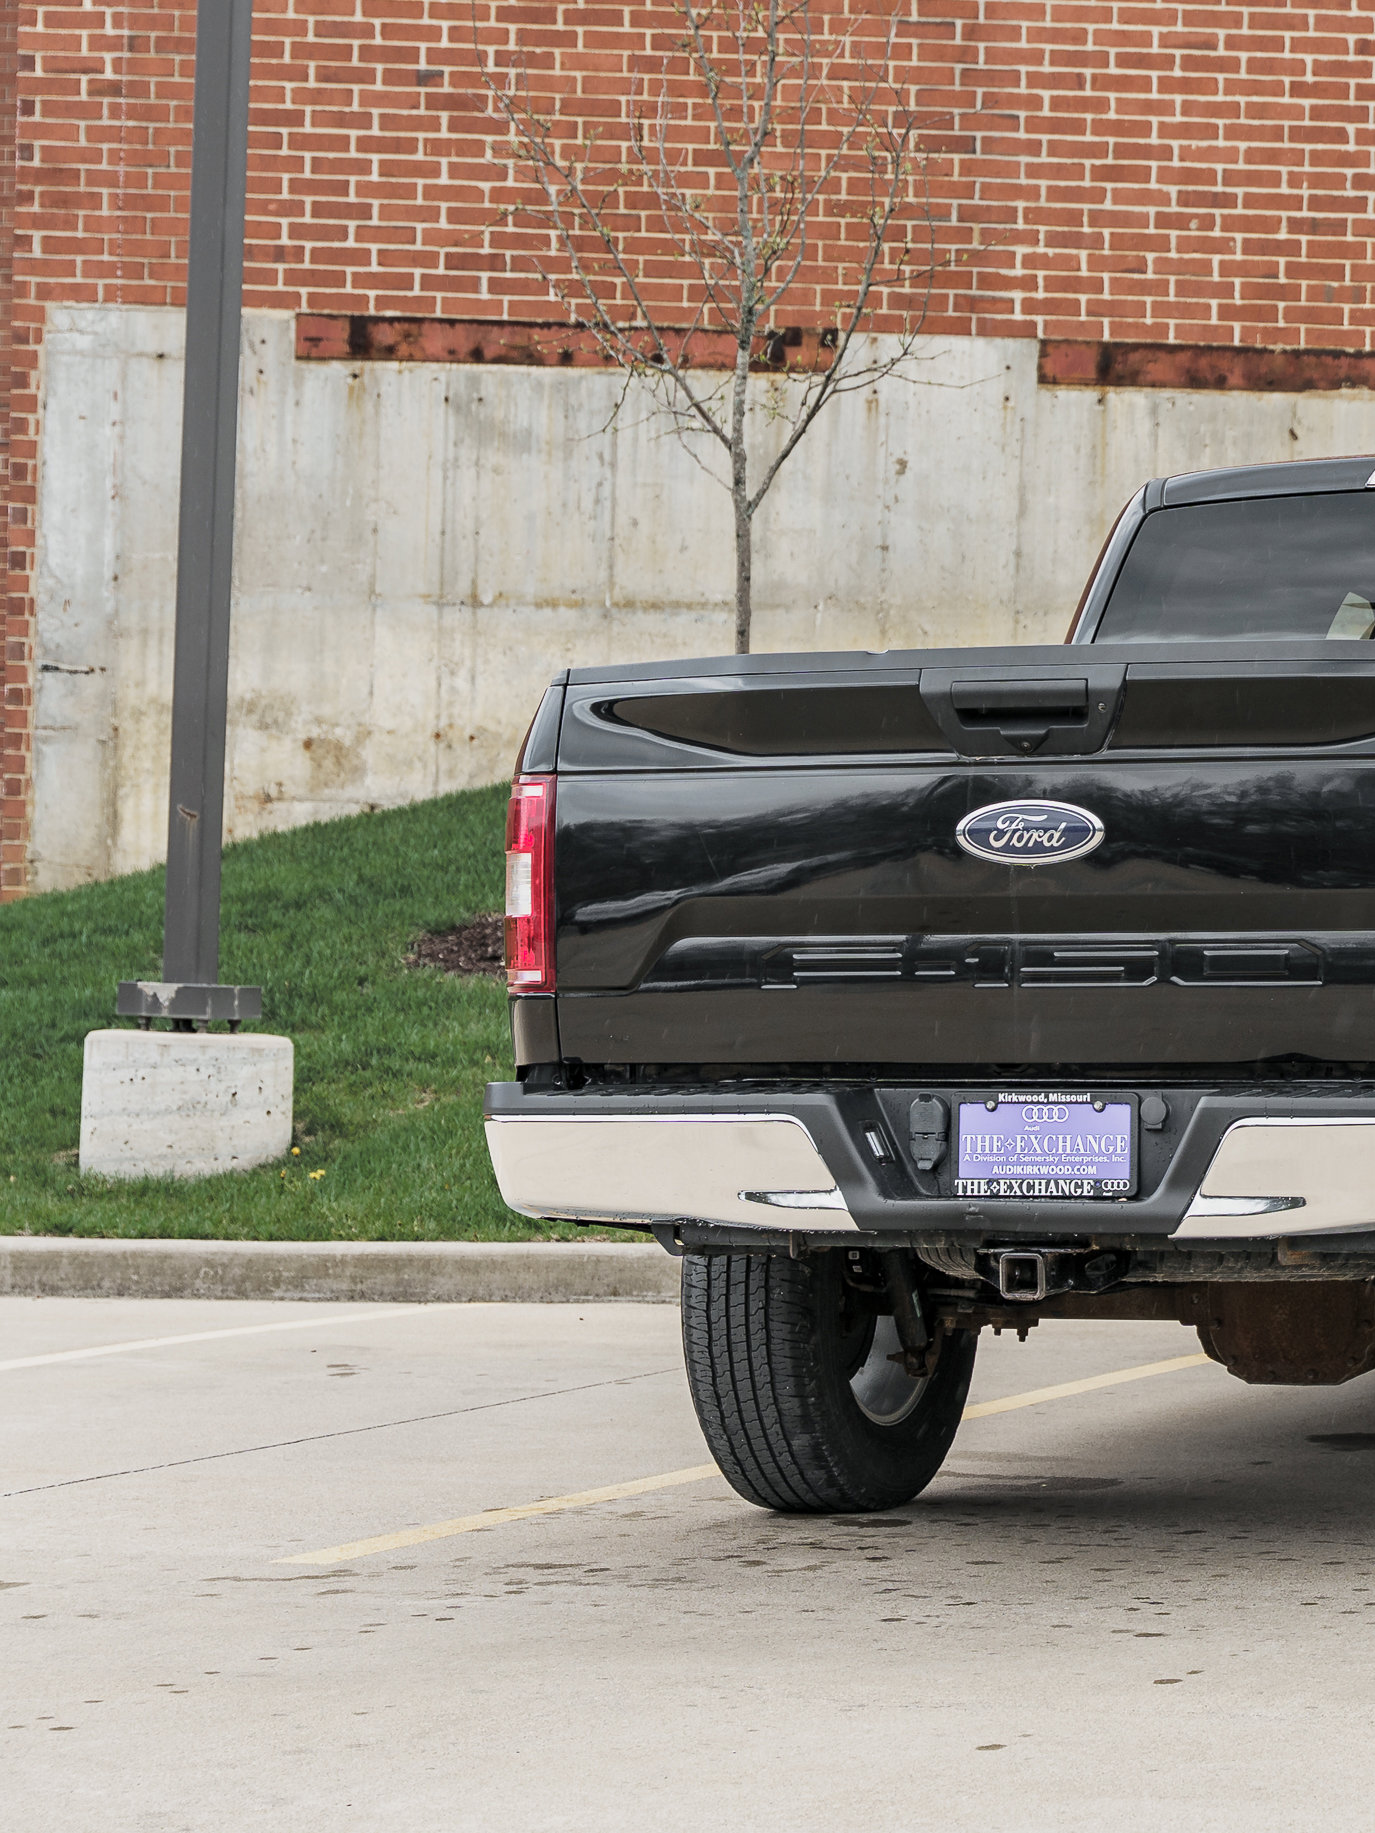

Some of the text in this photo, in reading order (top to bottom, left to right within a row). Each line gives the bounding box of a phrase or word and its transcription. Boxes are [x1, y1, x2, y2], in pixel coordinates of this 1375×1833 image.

[989, 813, 1067, 848] Ford
[998, 1093, 1091, 1103] Kirkwood, Missouri
[962, 1134, 1128, 1154] THE EXCHANGE
[963, 1154, 971, 1162] A
[973, 1154, 1006, 1162] Division
[1008, 1154, 1018, 1162] of
[1019, 1154, 1059, 1164] Semersky
[1112, 1154, 1127, 1162] Inc.
[992, 1165, 1097, 1175] AUDIKIRKWOOD.COM
[954, 1179, 1094, 1196] THE EXCHANGE
